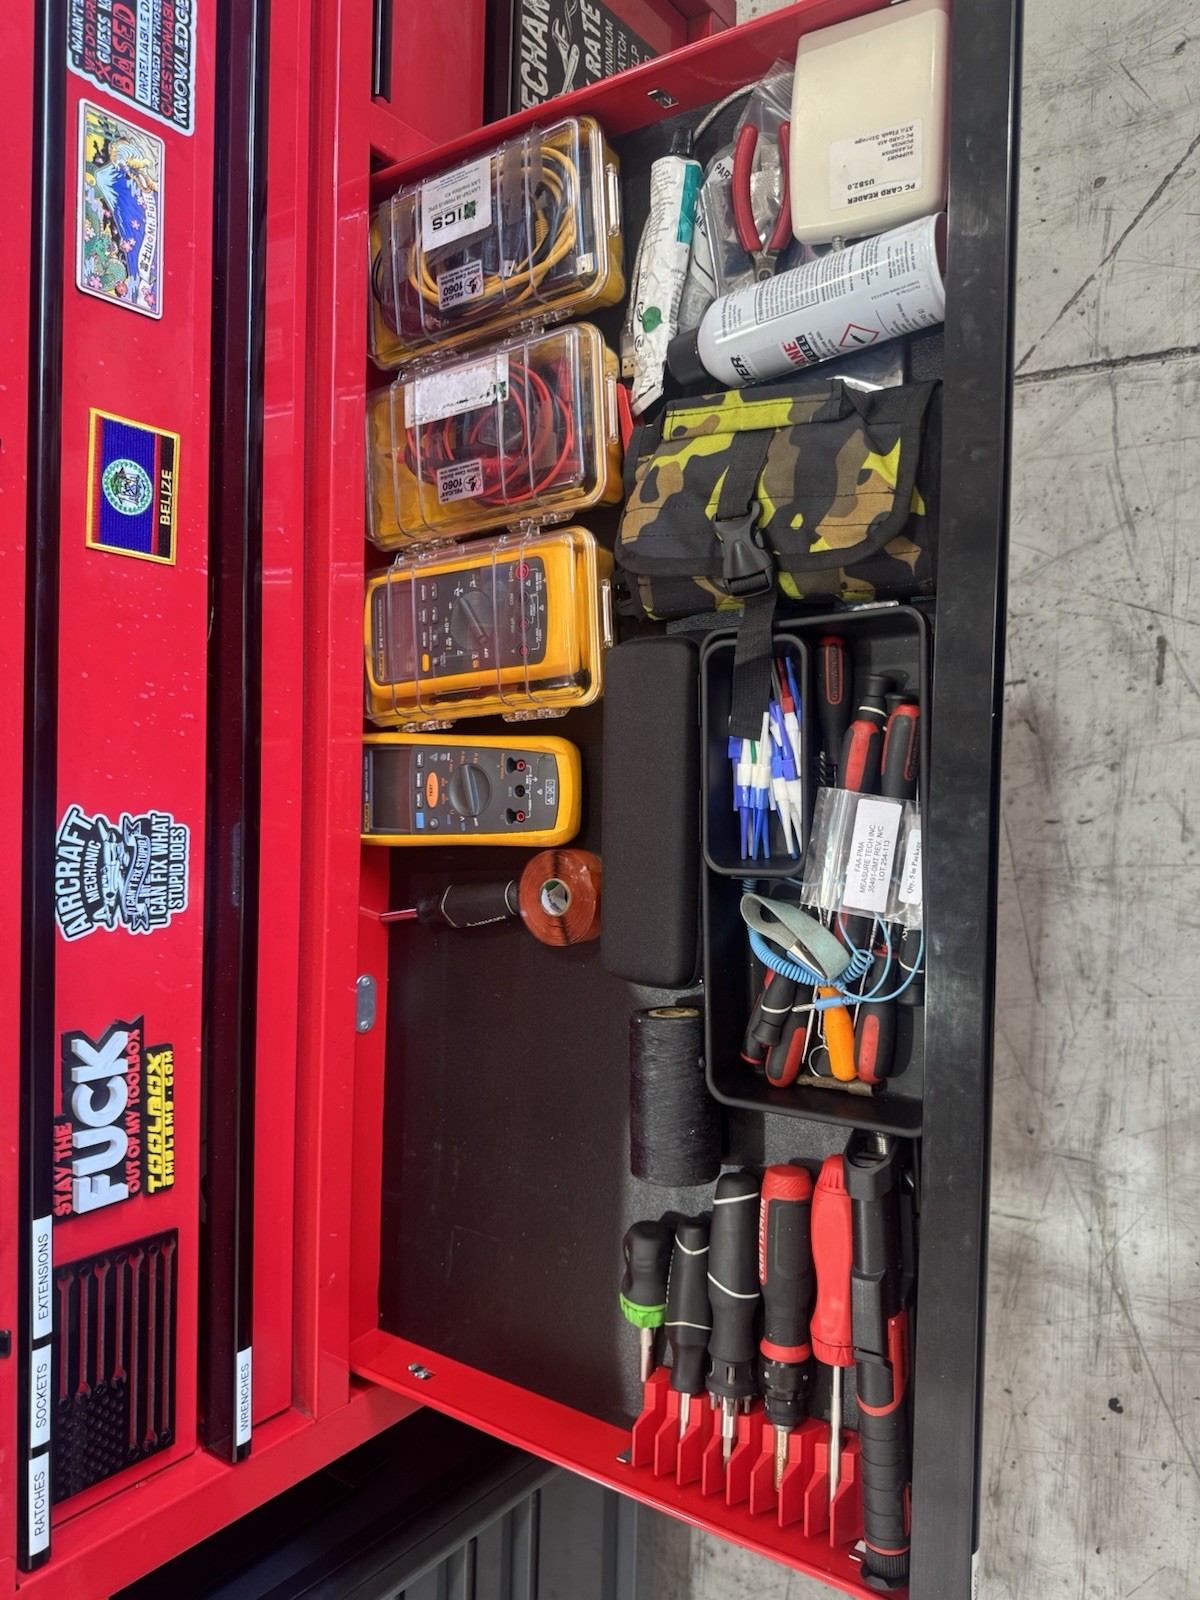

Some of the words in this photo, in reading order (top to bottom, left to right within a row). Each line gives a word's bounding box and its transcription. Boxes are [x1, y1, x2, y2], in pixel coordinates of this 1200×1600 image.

[85, 23, 96, 47] DO
[97, 13, 112, 64] GUESS
[111, 2, 136, 97] BASED
[152, 36, 161, 55] BY
[580, 0, 602, 78] RATE
[85, 47, 96, 71] WE
[139, 14, 150, 100] UNRELIABLE
[173, 0, 190, 126] KNOWLEDGE
[618, 31, 627, 73] ATCH
[152, 55, 161, 111] PROVIDED
[881, 129, 899, 138] Flash
[888, 134, 905, 143] CARD
[905, 132, 914, 140] PC
[887, 150, 914, 162] SUPPORT
[847, 178, 875, 191] USB2.0
[847, 190, 879, 205] READER
[880, 185, 903, 196] CARD
[905, 182, 916, 191] PC
[431, 207, 462, 231] ICS
[139, 242, 152, 273] 富士山
[442, 281, 463, 297] 1060
[159, 468, 173, 526] BELIZE
[442, 478, 463, 491] 1060
[150, 814, 169, 856] WHAT
[170, 827, 186, 860] DOES
[864, 838, 875, 857] TECH
[876, 825, 885, 839] N/C
[853, 841, 865, 873] FAA-PMA
[880, 839, 891, 866] 254-113
[54, 809, 93, 936] AIRCRAFT
[83, 840, 102, 903] MECHANIC
[132, 868, 143, 882] FIX
[150, 859, 168, 883] FIX
[168, 863, 184, 909] STUPID
[859, 858, 871, 894] MEASURE
[878, 867, 887, 881] LOT
[126, 882, 139, 907] CAN'T
[140, 883, 152, 898] BUT
[149, 885, 168, 915] CAN
[126, 1028, 141, 1107] TOOLBOX
[71, 1029, 130, 1214] FUCK
[126, 1109, 141, 1134] MY
[146, 1052, 163, 1193] TOOLBOX
[53, 1121, 73, 1162] THE
[126, 1135, 141, 1159] OF
[53, 1166, 72, 1217] STAY
[126, 1160, 141, 1193] OUT
[758, 1197, 767, 1281] CRAFTSMAN
[37, 1233, 49, 1320] EXTENSIONS
[35, 1363, 48, 1429] SOCKETS
[240, 1362, 250, 1432] WRENCHES
[33, 1470, 46, 1537] RATCHES
